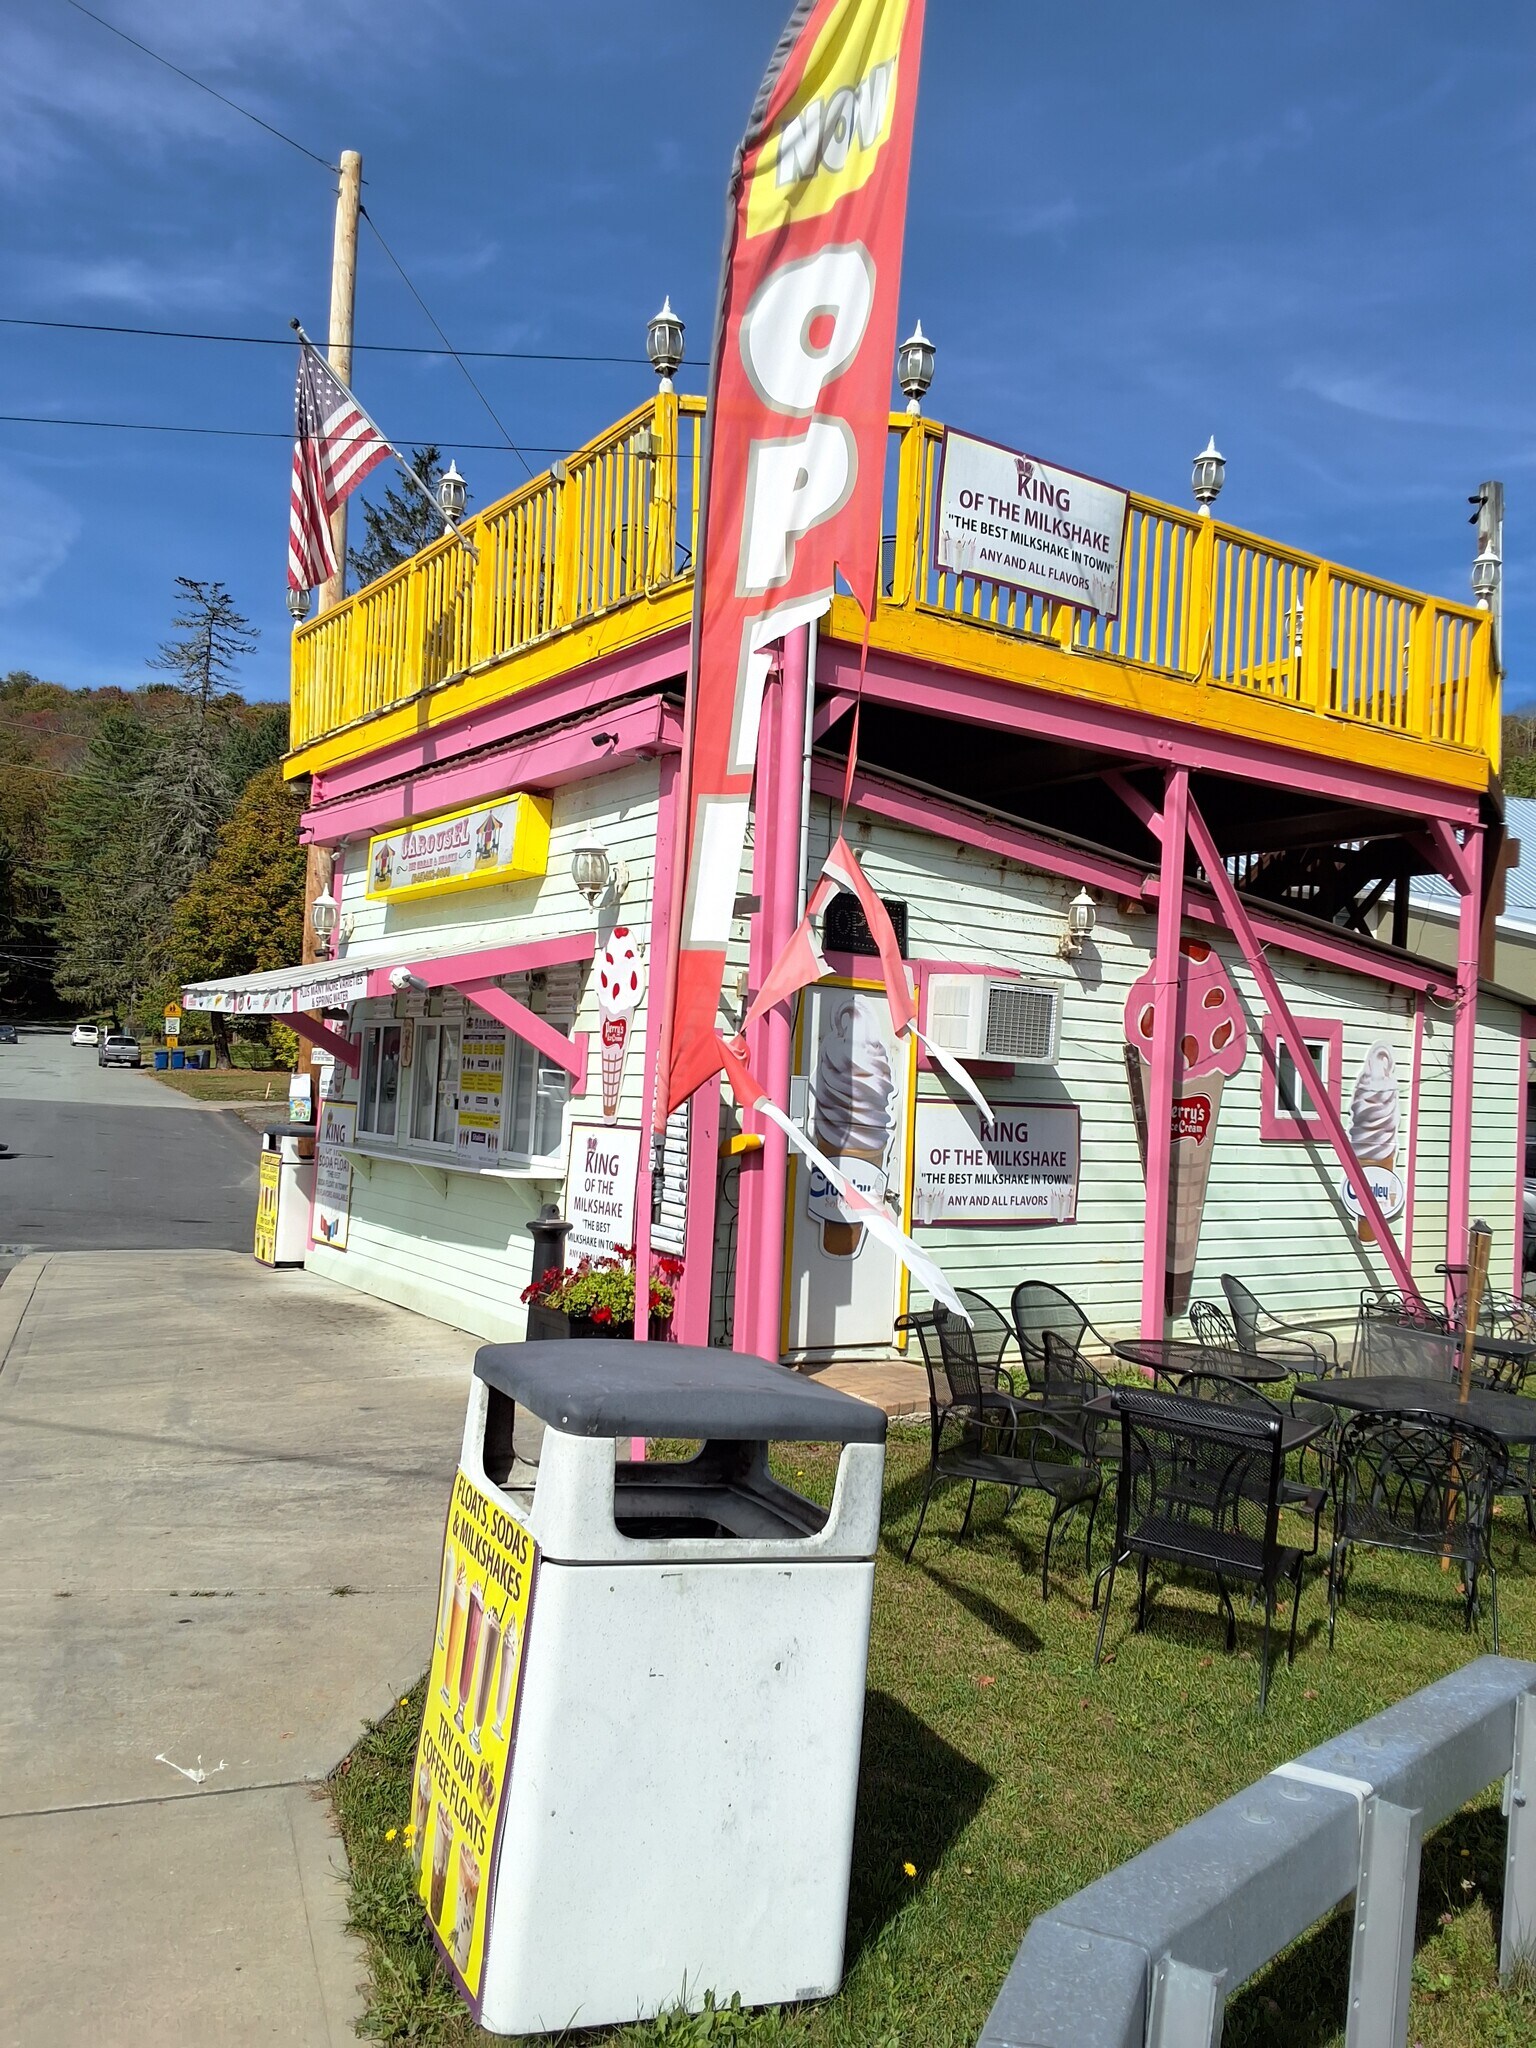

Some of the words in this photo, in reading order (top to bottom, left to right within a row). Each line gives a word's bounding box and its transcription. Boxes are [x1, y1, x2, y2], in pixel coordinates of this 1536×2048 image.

[1017, 474, 1070, 512] KING
[959, 489, 984, 511] OF
[988, 496, 1020, 523] THE
[1024, 508, 1110, 553] MILKSHAKE
[948, 514, 977, 532] "THE
[980, 523, 1008, 540] BEST
[1010, 529, 1069, 560] MILKSHAKE
[1071, 550, 1082, 563] IN
[1084, 554, 1115, 575] TOWN"
[979, 547, 1003, 563] ANY
[1004, 554, 1026, 570] AND
[1028, 561, 1046, 577] ALL
[1048, 567, 1090, 590] FLAVORS
[401, 818, 471, 860] CAROUSEL
[1171, 1103, 1205, 1124] erry's
[325, 1122, 346, 1143] KING
[980, 1121, 1028, 1143] KING
[1179, 1120, 1203, 1133] Cream
[585, 1151, 619, 1176] KING
[930, 1149, 951, 1165] OF
[954, 1149, 983, 1166] THE
[986, 1150, 1066, 1167] MILKSHAKE
[584, 1178, 596, 1193] OF
[598, 1179, 614, 1196] THE
[921, 1173, 945, 1185] "THE
[948, 1173, 971, 1185] BEST
[974, 1174, 1029, 1185] MILKSHAKE
[1031, 1174, 1040, 1185] IN
[1042, 1175, 1072, 1185] TOWN"
[948, 1195, 967, 1206] ANY
[969, 1195, 989, 1206] AND
[991, 1195, 1007, 1206] ALL
[1010, 1195, 1048, 1206] FLAVORS
[1346, 1182, 1388, 1200] Cley
[573, 1196, 623, 1218] MILKSHAKE
[596, 1221, 611, 1233] BEST
[567, 1231, 597, 1248] MILKSHAKE
[598, 1238, 605, 1249] IN
[606, 1239, 628, 1251] TO"
[456, 1475, 489, 1531] FLOATS,
[490, 1509, 528, 1565] SODAS
[452, 1510, 460, 1537] &
[459, 1517, 522, 1602] MILKSHAKES
[439, 1712, 454, 1759] TRY
[453, 1741, 475, 1793] OUR
[422, 1729, 451, 1800] COFFEE
[449, 1778, 487, 1856] FLOATS
